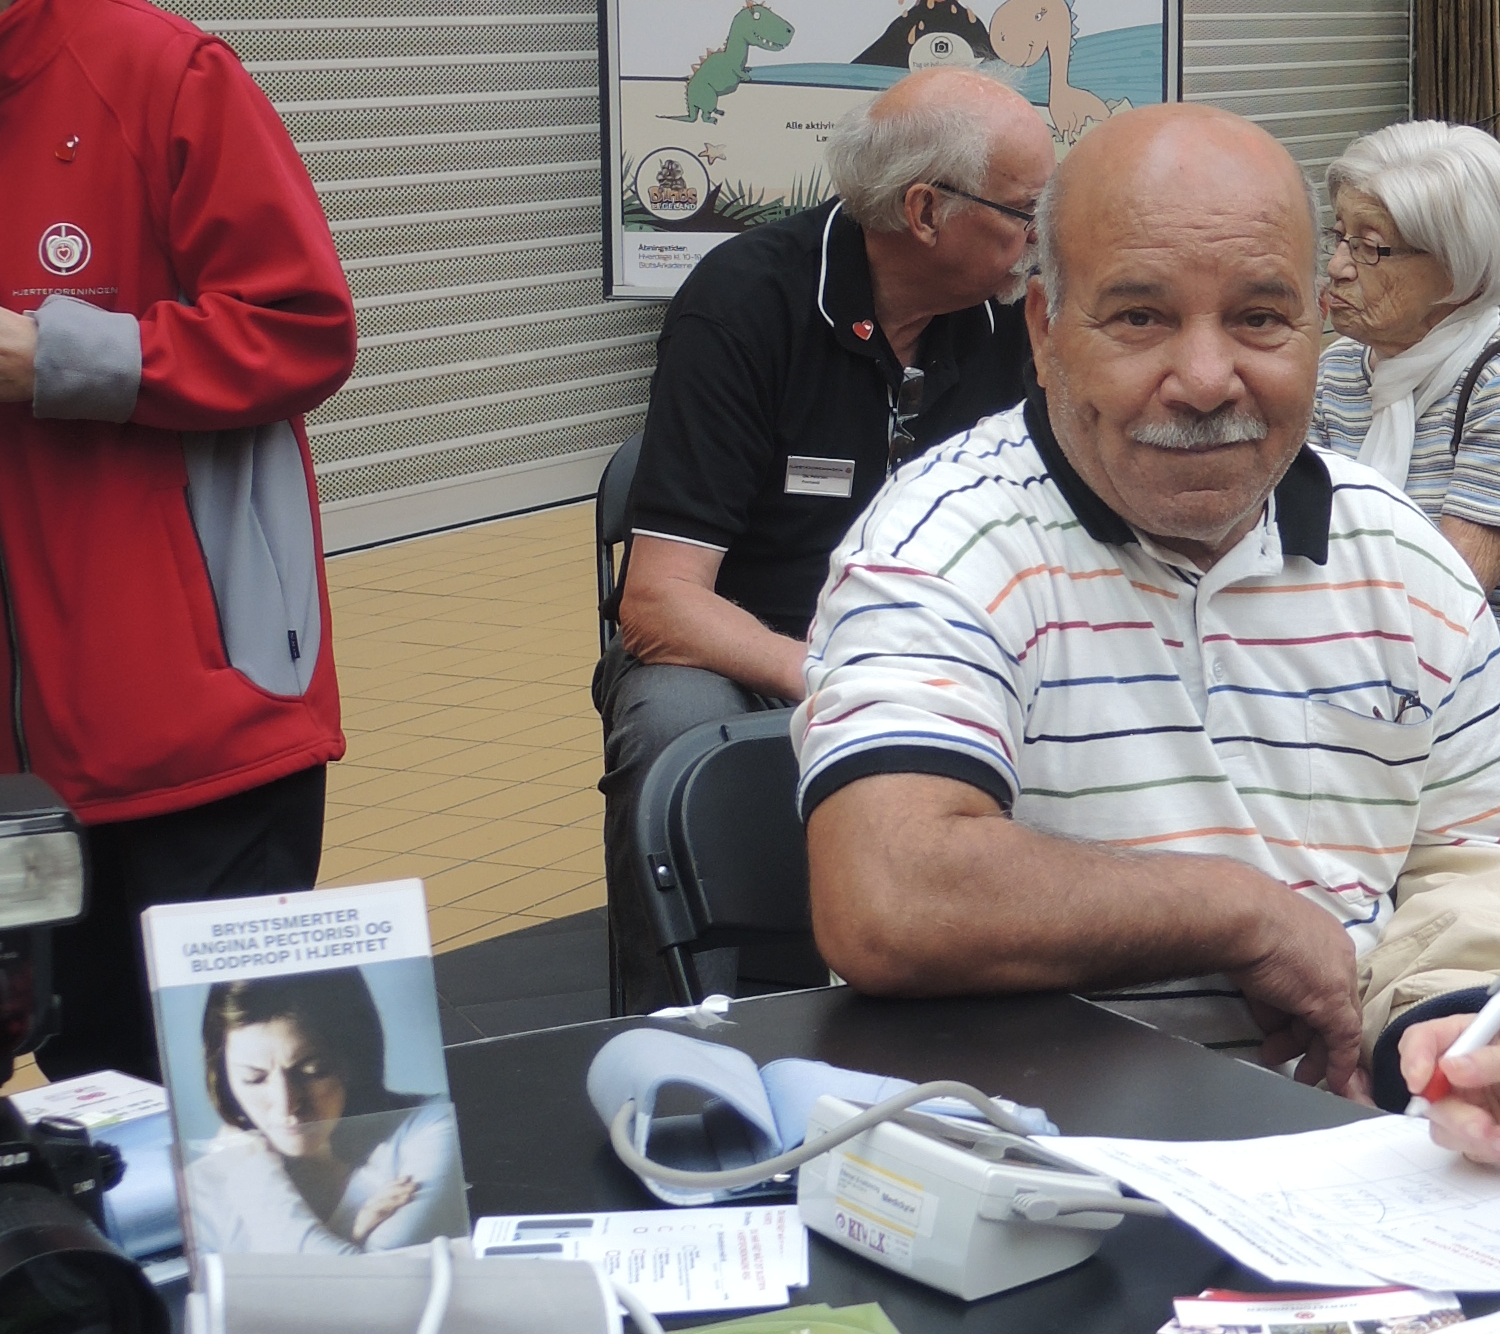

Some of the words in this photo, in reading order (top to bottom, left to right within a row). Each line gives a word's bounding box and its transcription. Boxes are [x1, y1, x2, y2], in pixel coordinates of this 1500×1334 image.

[182, 937, 259, 957] (ANGINA
[264, 924, 361, 948] PECTORIS)
[365, 920, 393, 935] OG
[211, 909, 359, 937] BRYSTSMERTER
[191, 950, 290, 973] BLODPROP
[306, 937, 388, 960] HJERTET
